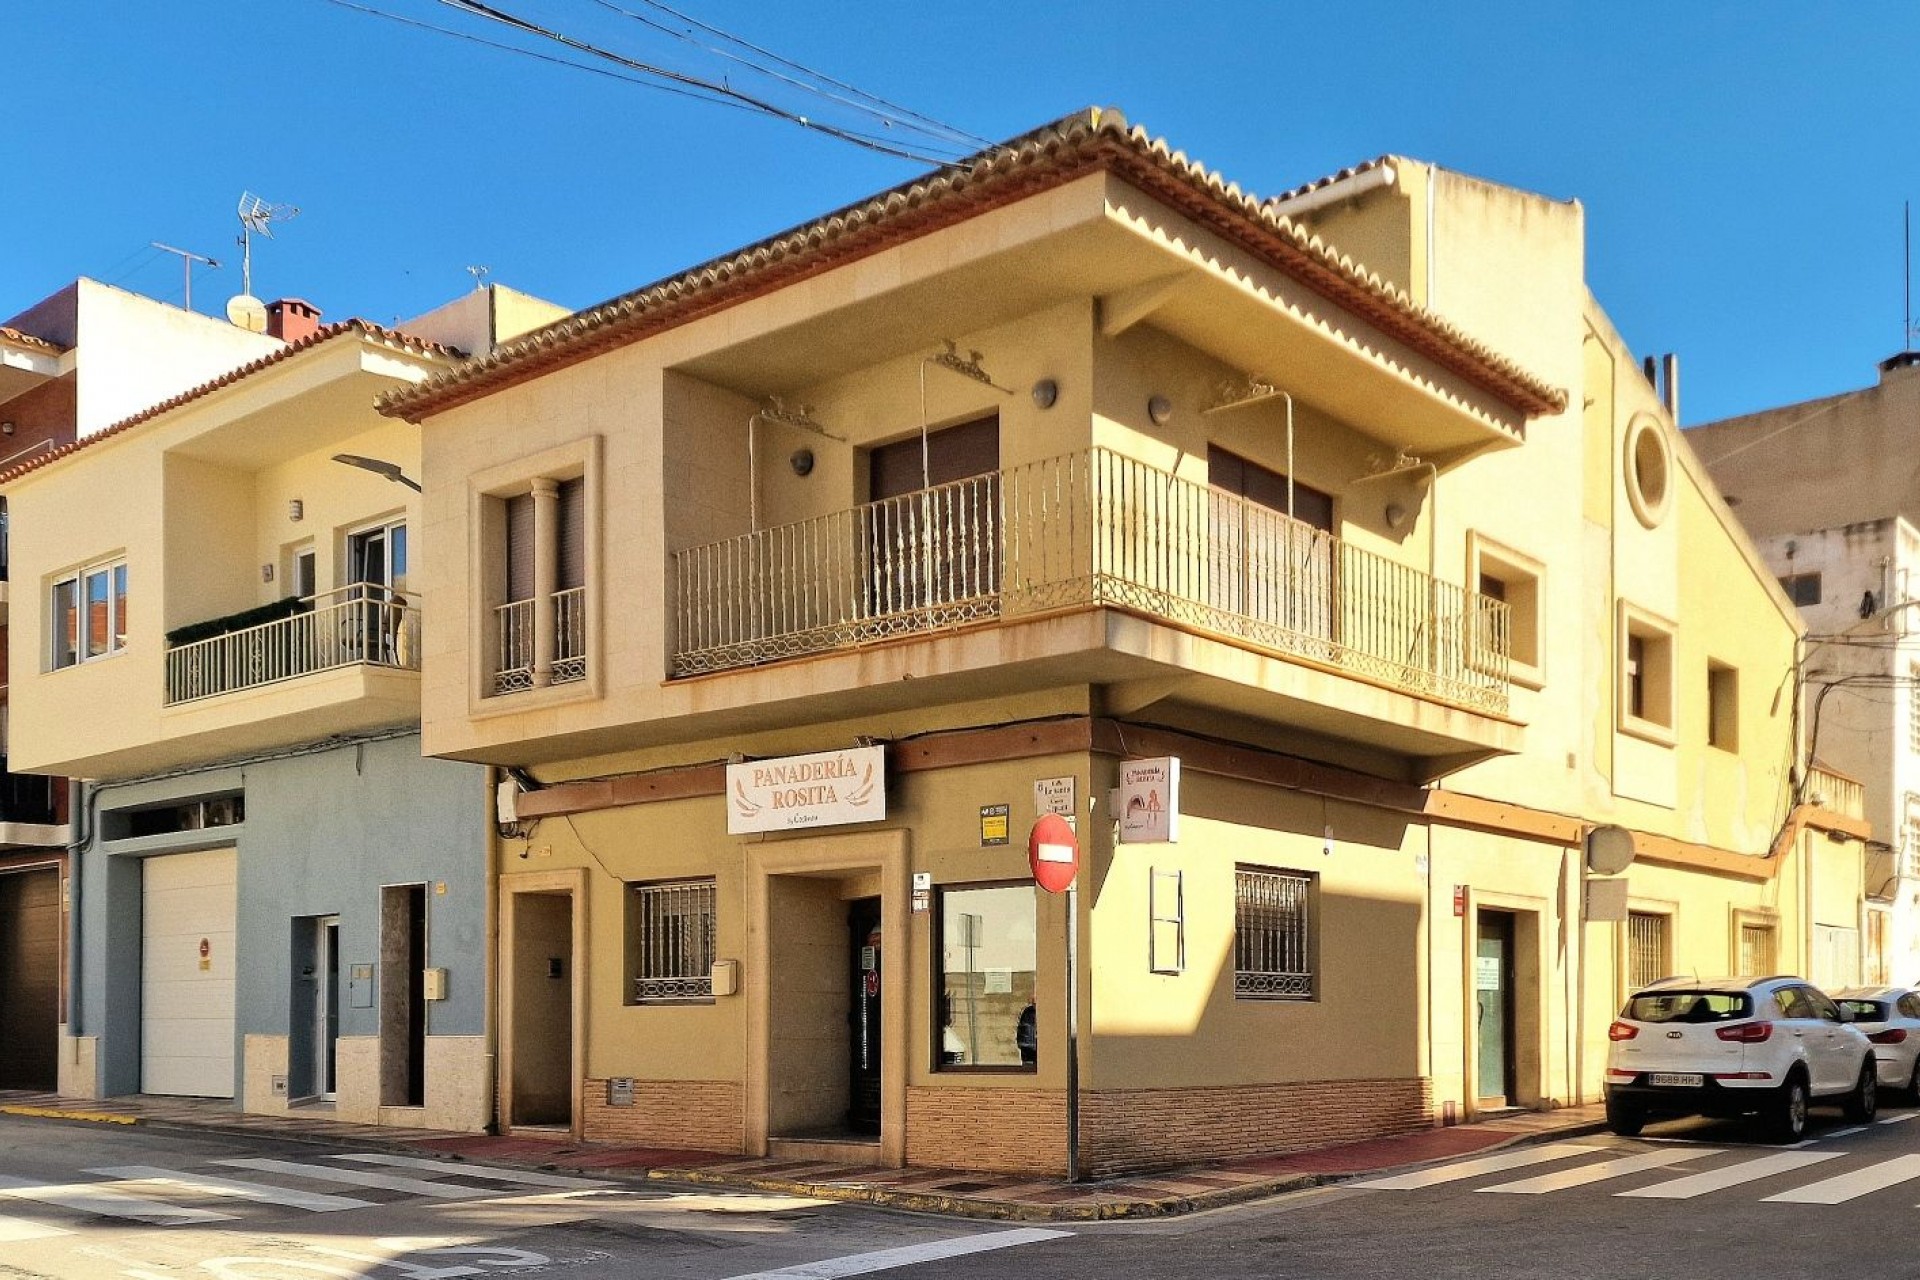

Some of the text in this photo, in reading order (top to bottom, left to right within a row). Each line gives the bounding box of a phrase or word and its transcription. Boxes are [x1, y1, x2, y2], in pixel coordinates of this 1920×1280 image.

[753, 754, 857, 788] PANADERÍA
[772, 785, 838, 810] ROSITA
[1667, 1031, 1682, 1039] KIA
